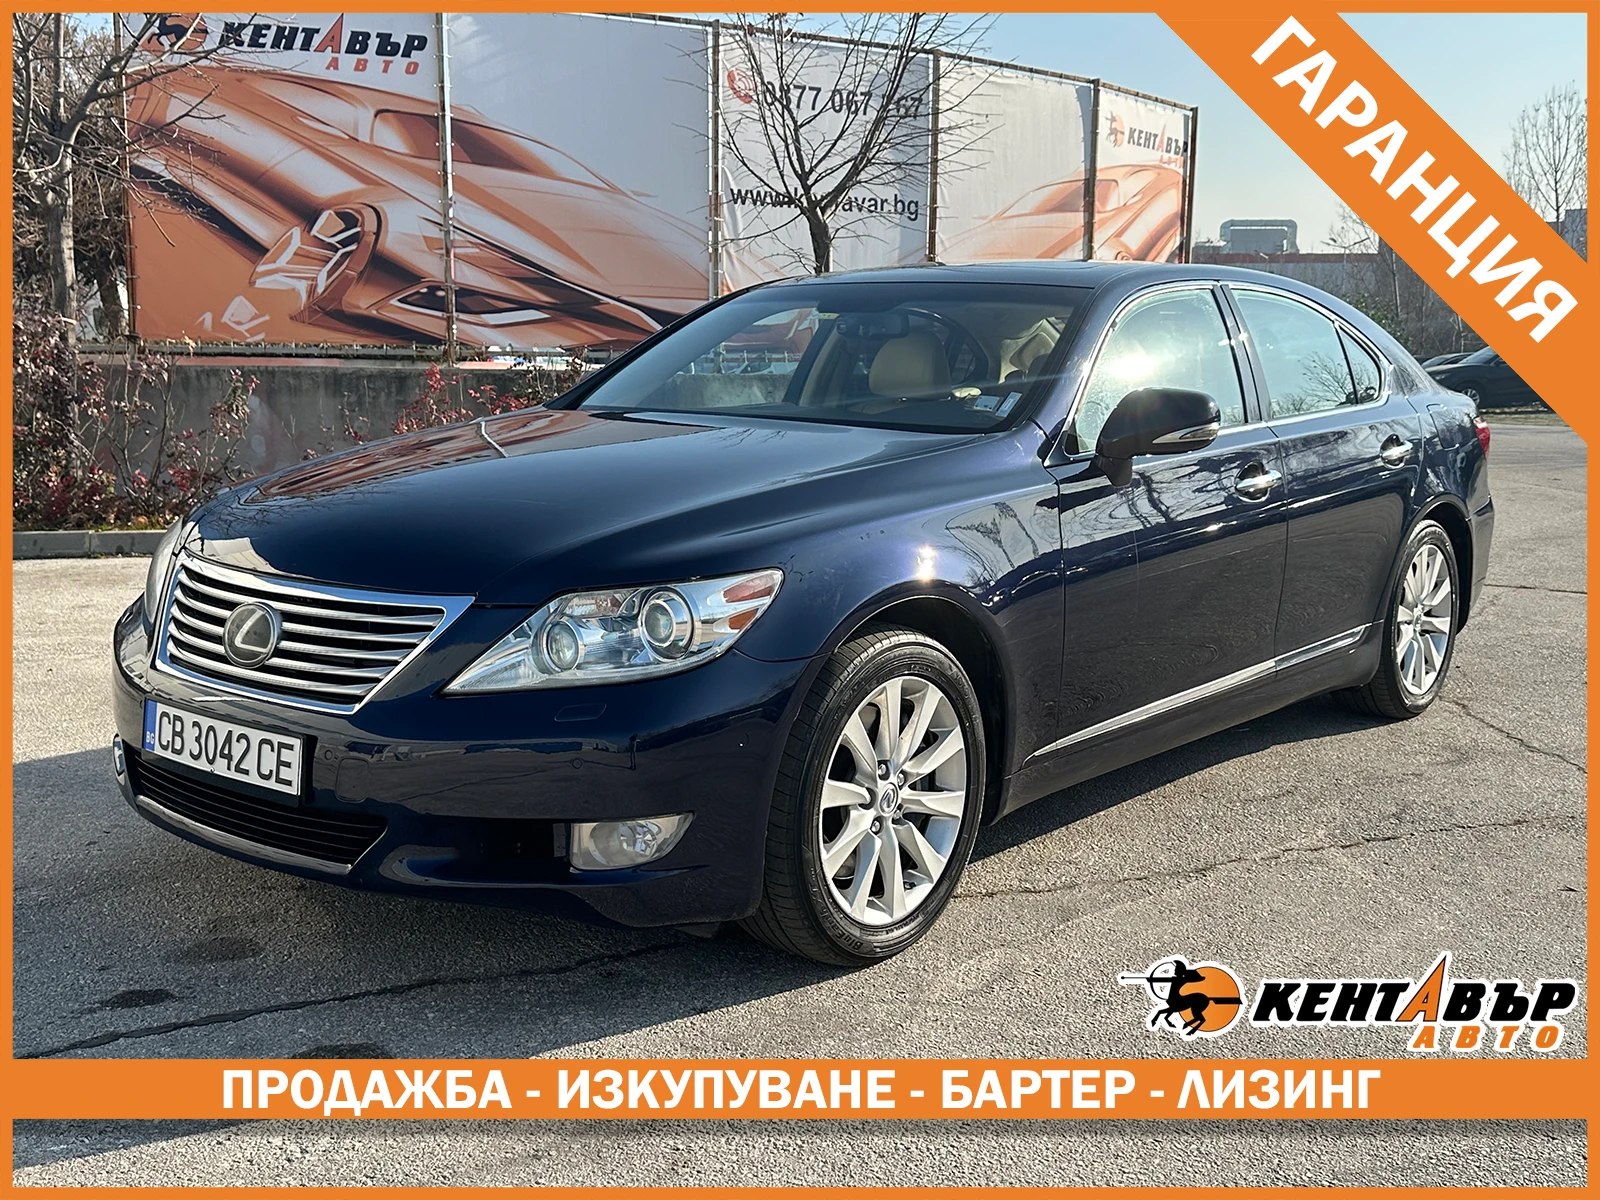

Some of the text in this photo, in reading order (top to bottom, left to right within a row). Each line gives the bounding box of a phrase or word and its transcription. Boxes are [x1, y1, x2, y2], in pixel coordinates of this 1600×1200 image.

[219, 13, 428, 58] КЕНТАВЪР
[325, 58, 419, 75] АВТО
[764, 81, 822, 111] 0877
[1127, 123, 1188, 157] КЕНТАВЪР
[146, 730, 155, 745] BG
[158, 711, 295, 787] CB 3042 CE
